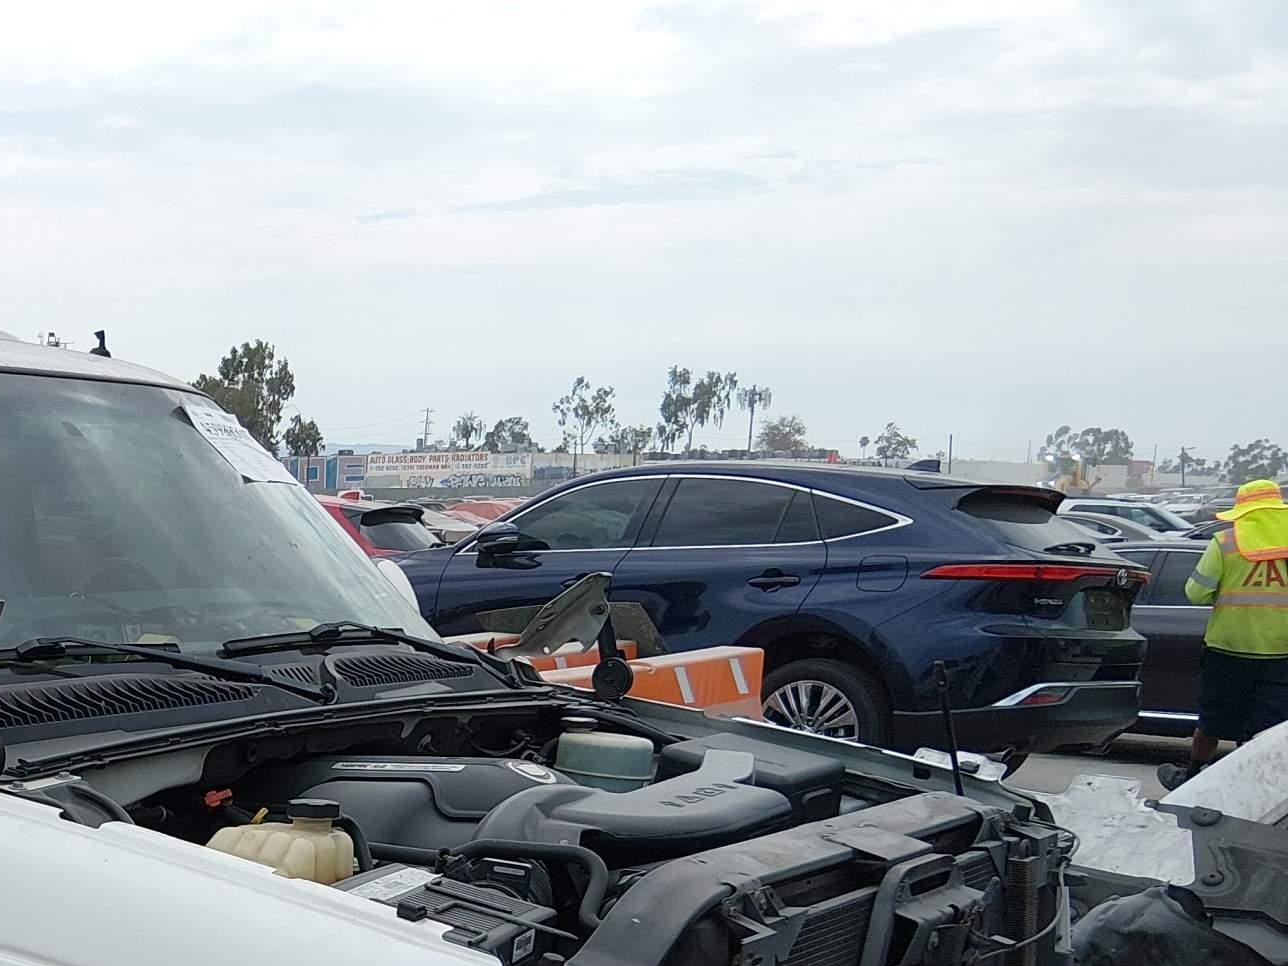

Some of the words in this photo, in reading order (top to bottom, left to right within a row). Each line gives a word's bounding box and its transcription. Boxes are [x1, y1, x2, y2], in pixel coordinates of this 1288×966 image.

[369, 456, 386, 464] AUTO
[387, 455, 407, 464] GLASS
[409, 455, 426, 463] BODY
[428, 454, 449, 463] PARTS
[451, 453, 488, 462] RADIATORS
